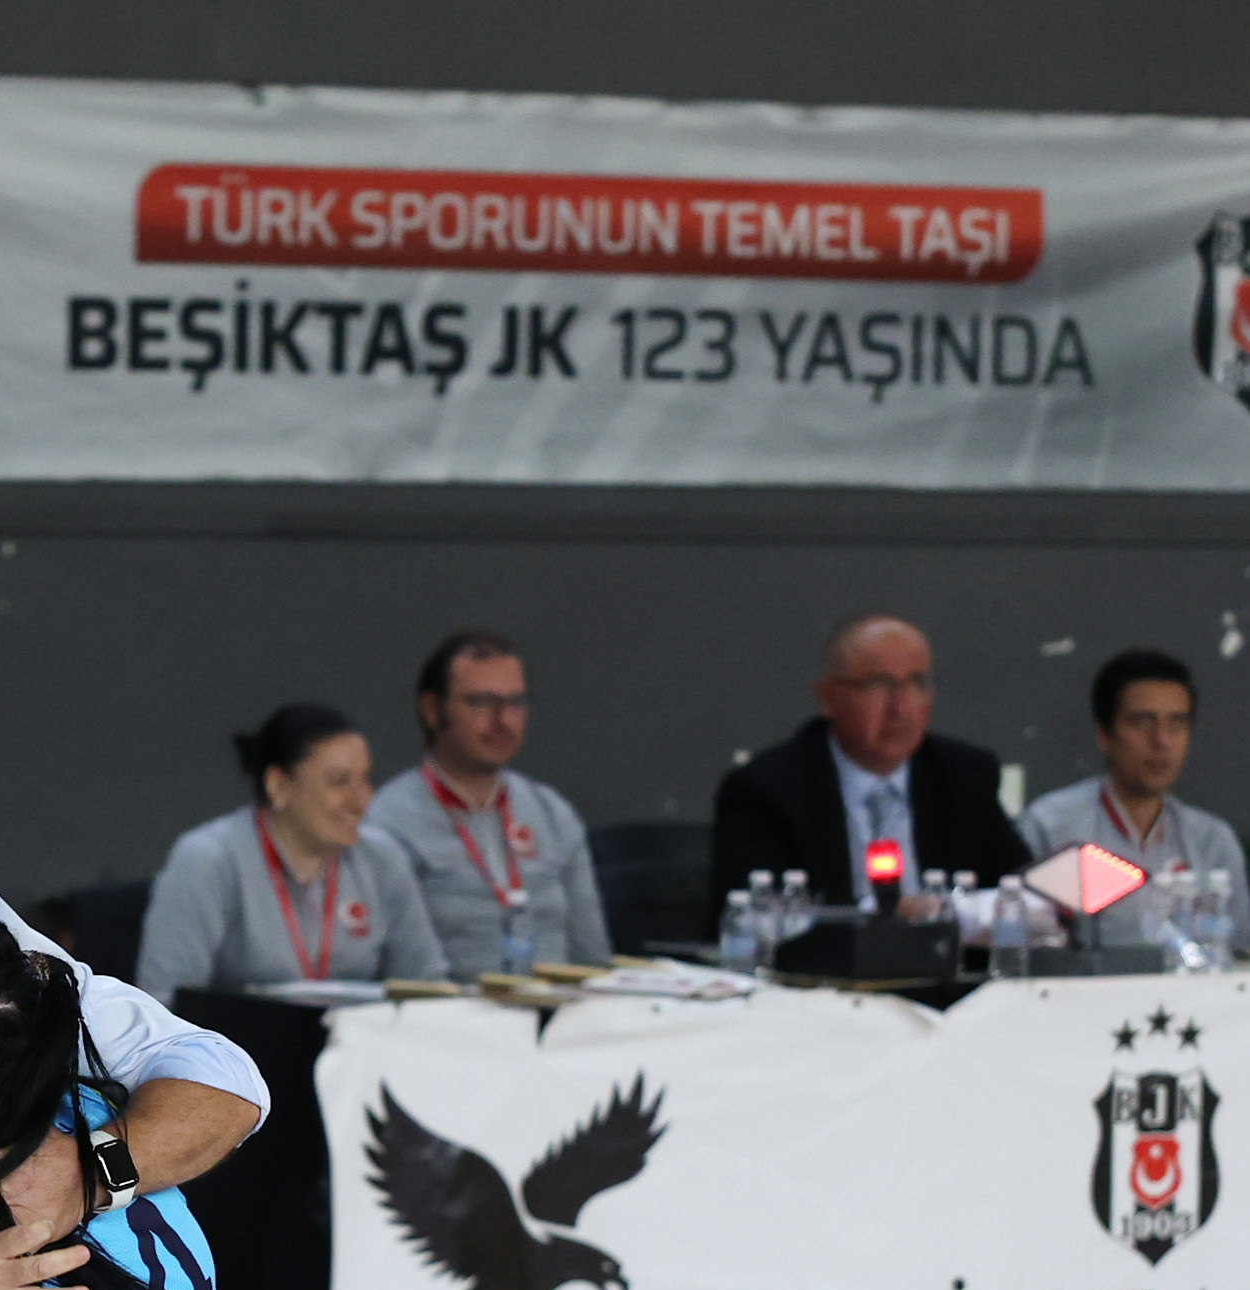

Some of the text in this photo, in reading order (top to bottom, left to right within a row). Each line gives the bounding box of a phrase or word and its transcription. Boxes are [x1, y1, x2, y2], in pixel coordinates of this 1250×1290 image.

[174, 172, 1010, 277] TÜRK SPORUNUN TEMEL TAŞI
[66, 279, 1095, 403] BEŞİKTAŞ JK 123 YAŞINDA
